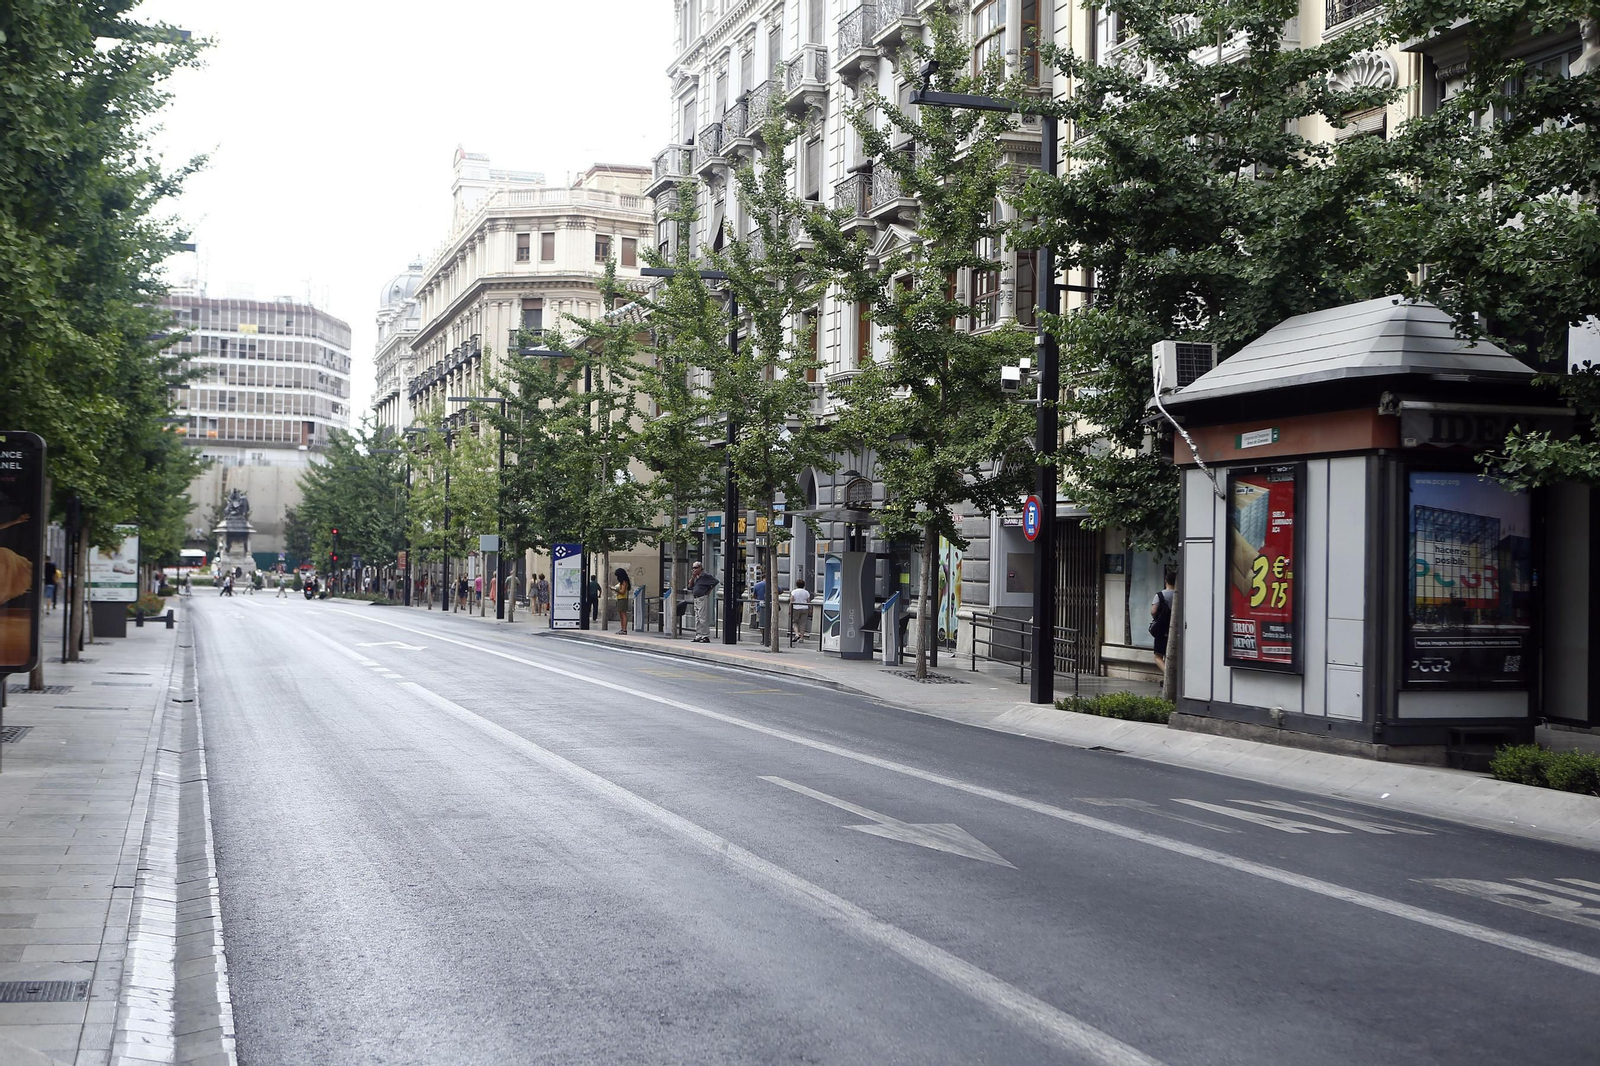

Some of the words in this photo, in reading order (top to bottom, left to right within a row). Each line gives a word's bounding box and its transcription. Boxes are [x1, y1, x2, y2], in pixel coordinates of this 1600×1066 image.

[1415, 478, 1460, 486] www.pcgr.org
[1434, 545, 1471, 556] hacemos
[1435, 556, 1467, 566] posible.
[1250, 556, 1269, 608] 3
[1272, 555, 1285, 579] €
[1271, 581, 1288, 609] 75
[1232, 622, 1254, 634] BRICO
[1233, 634, 1255, 649] DEPÔT
